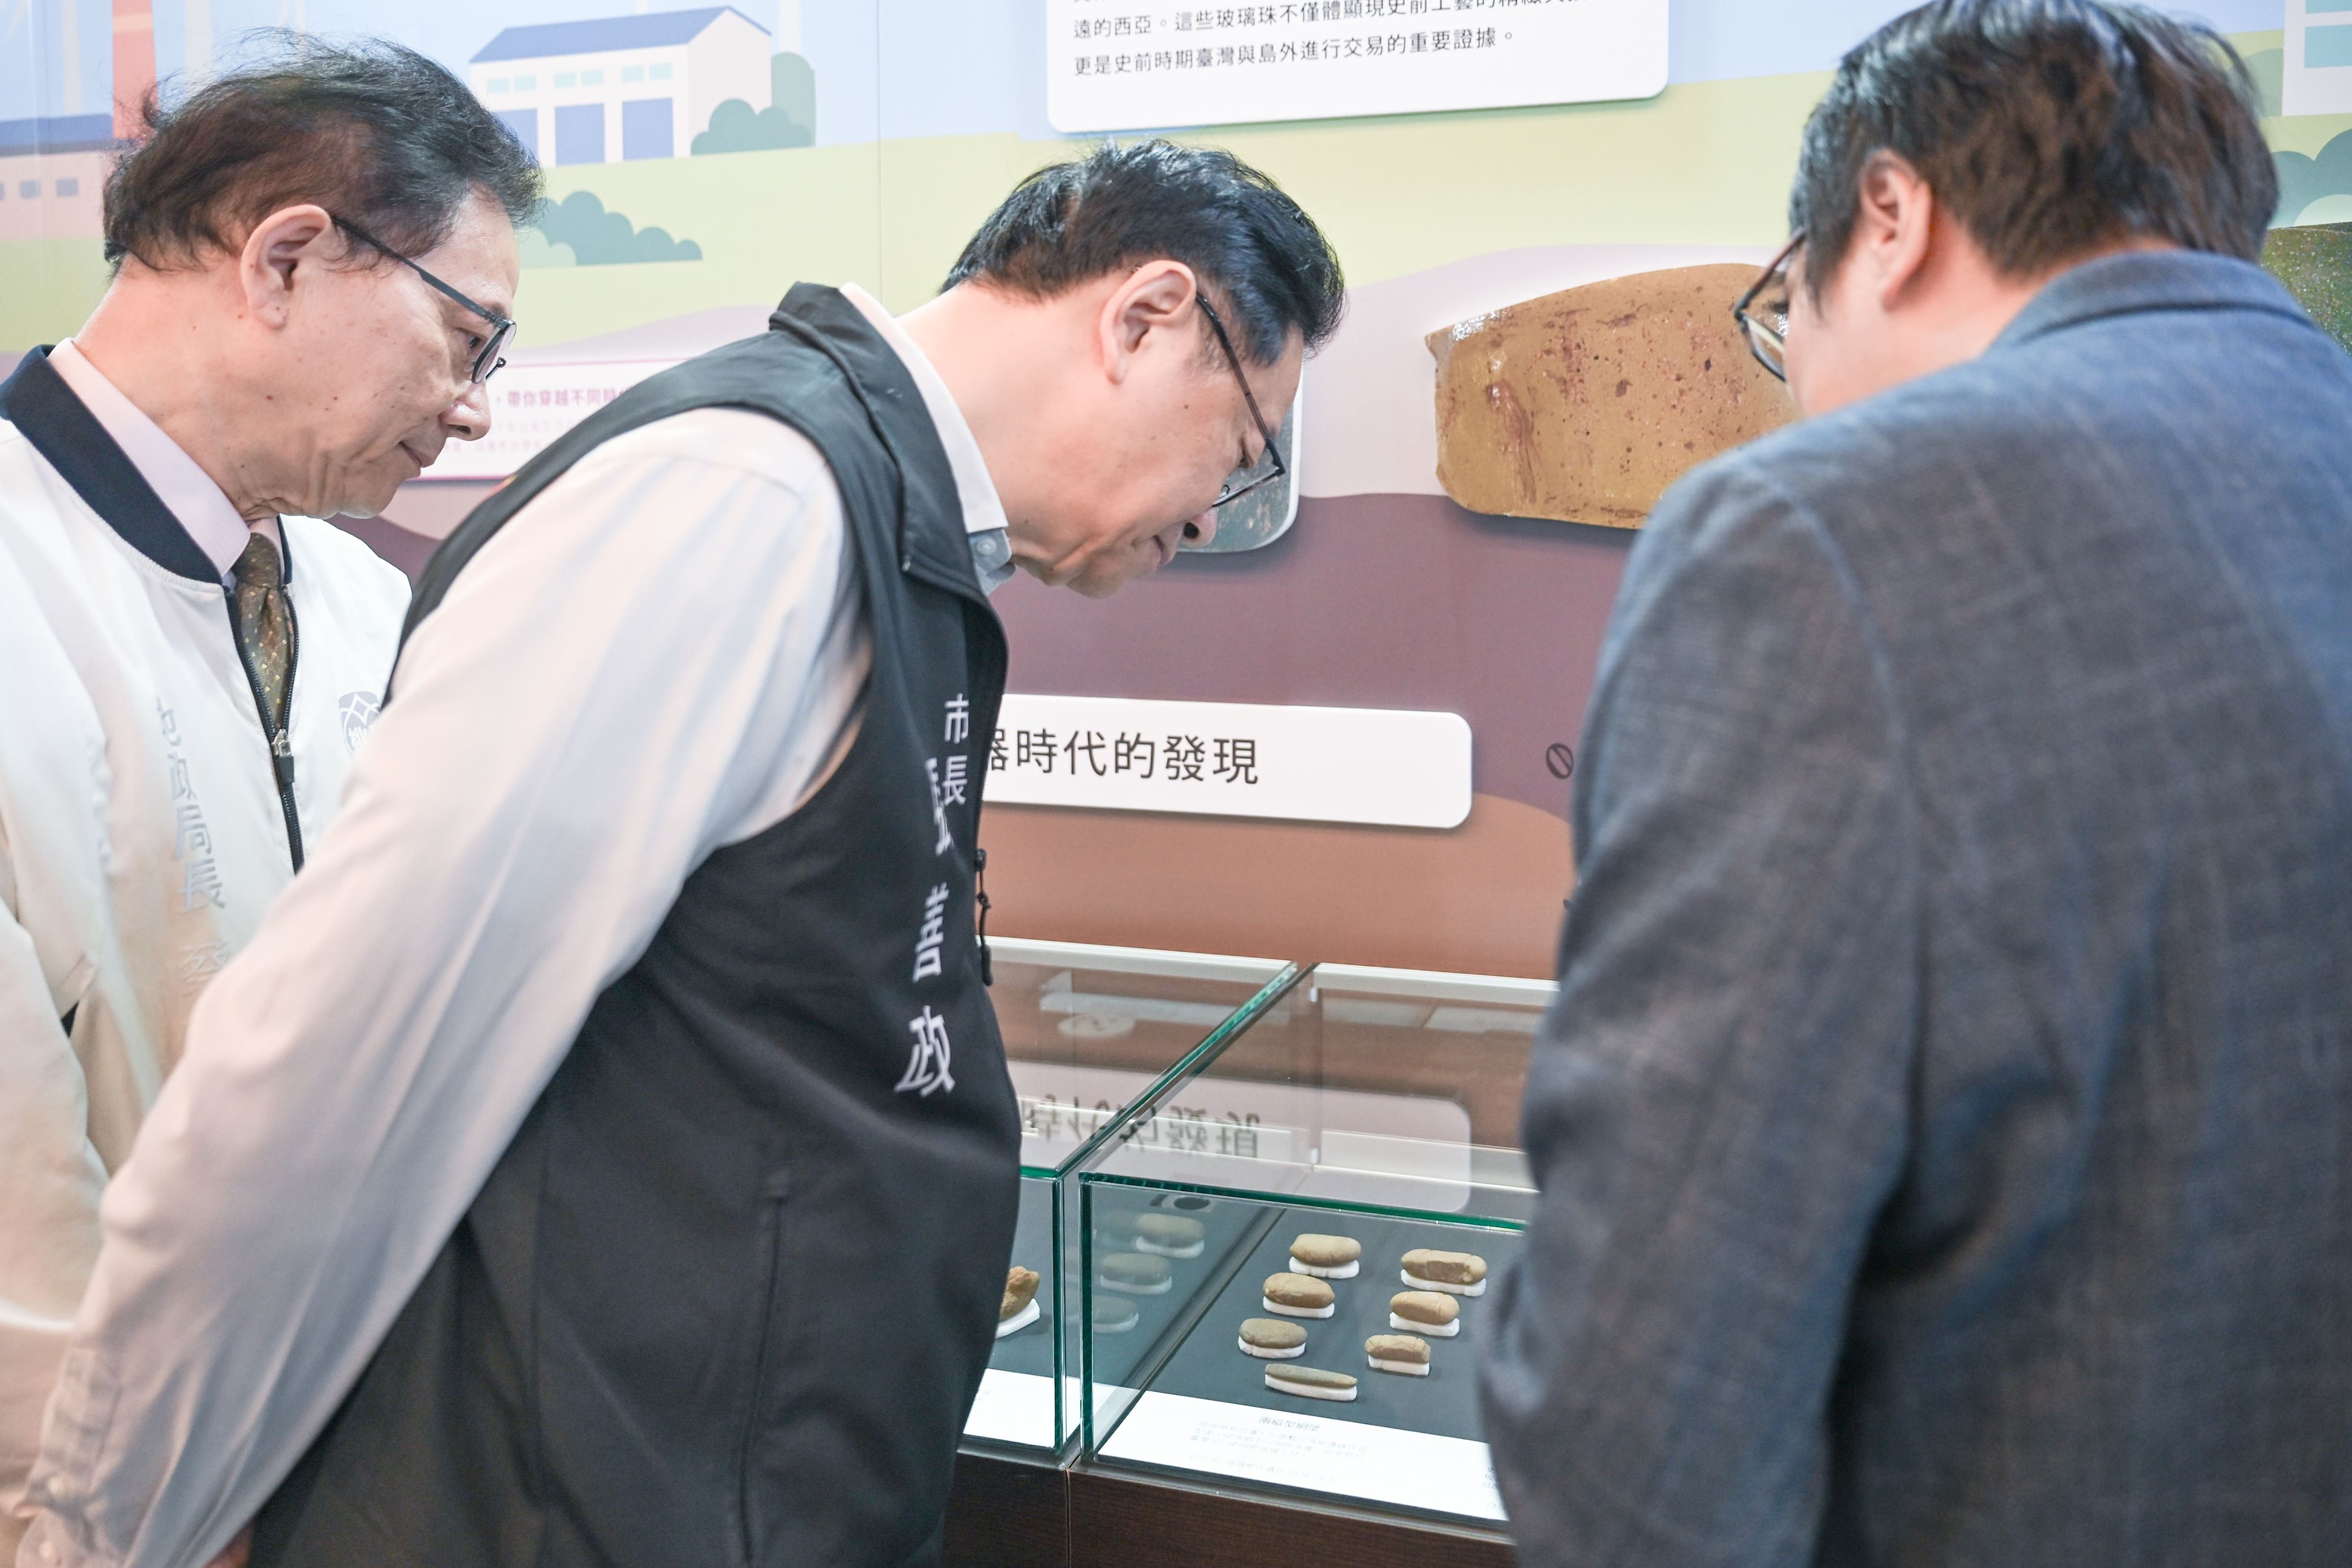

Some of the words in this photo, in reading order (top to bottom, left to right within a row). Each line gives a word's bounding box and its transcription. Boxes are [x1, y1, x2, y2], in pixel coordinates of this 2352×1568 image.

[1074, 27, 1513, 76] 更是史前時期臺灣與島外進行交易的重要證據。
[497, 388, 629, 407] ，帶你穿越不同時
[942, 693, 969, 806] 市長
